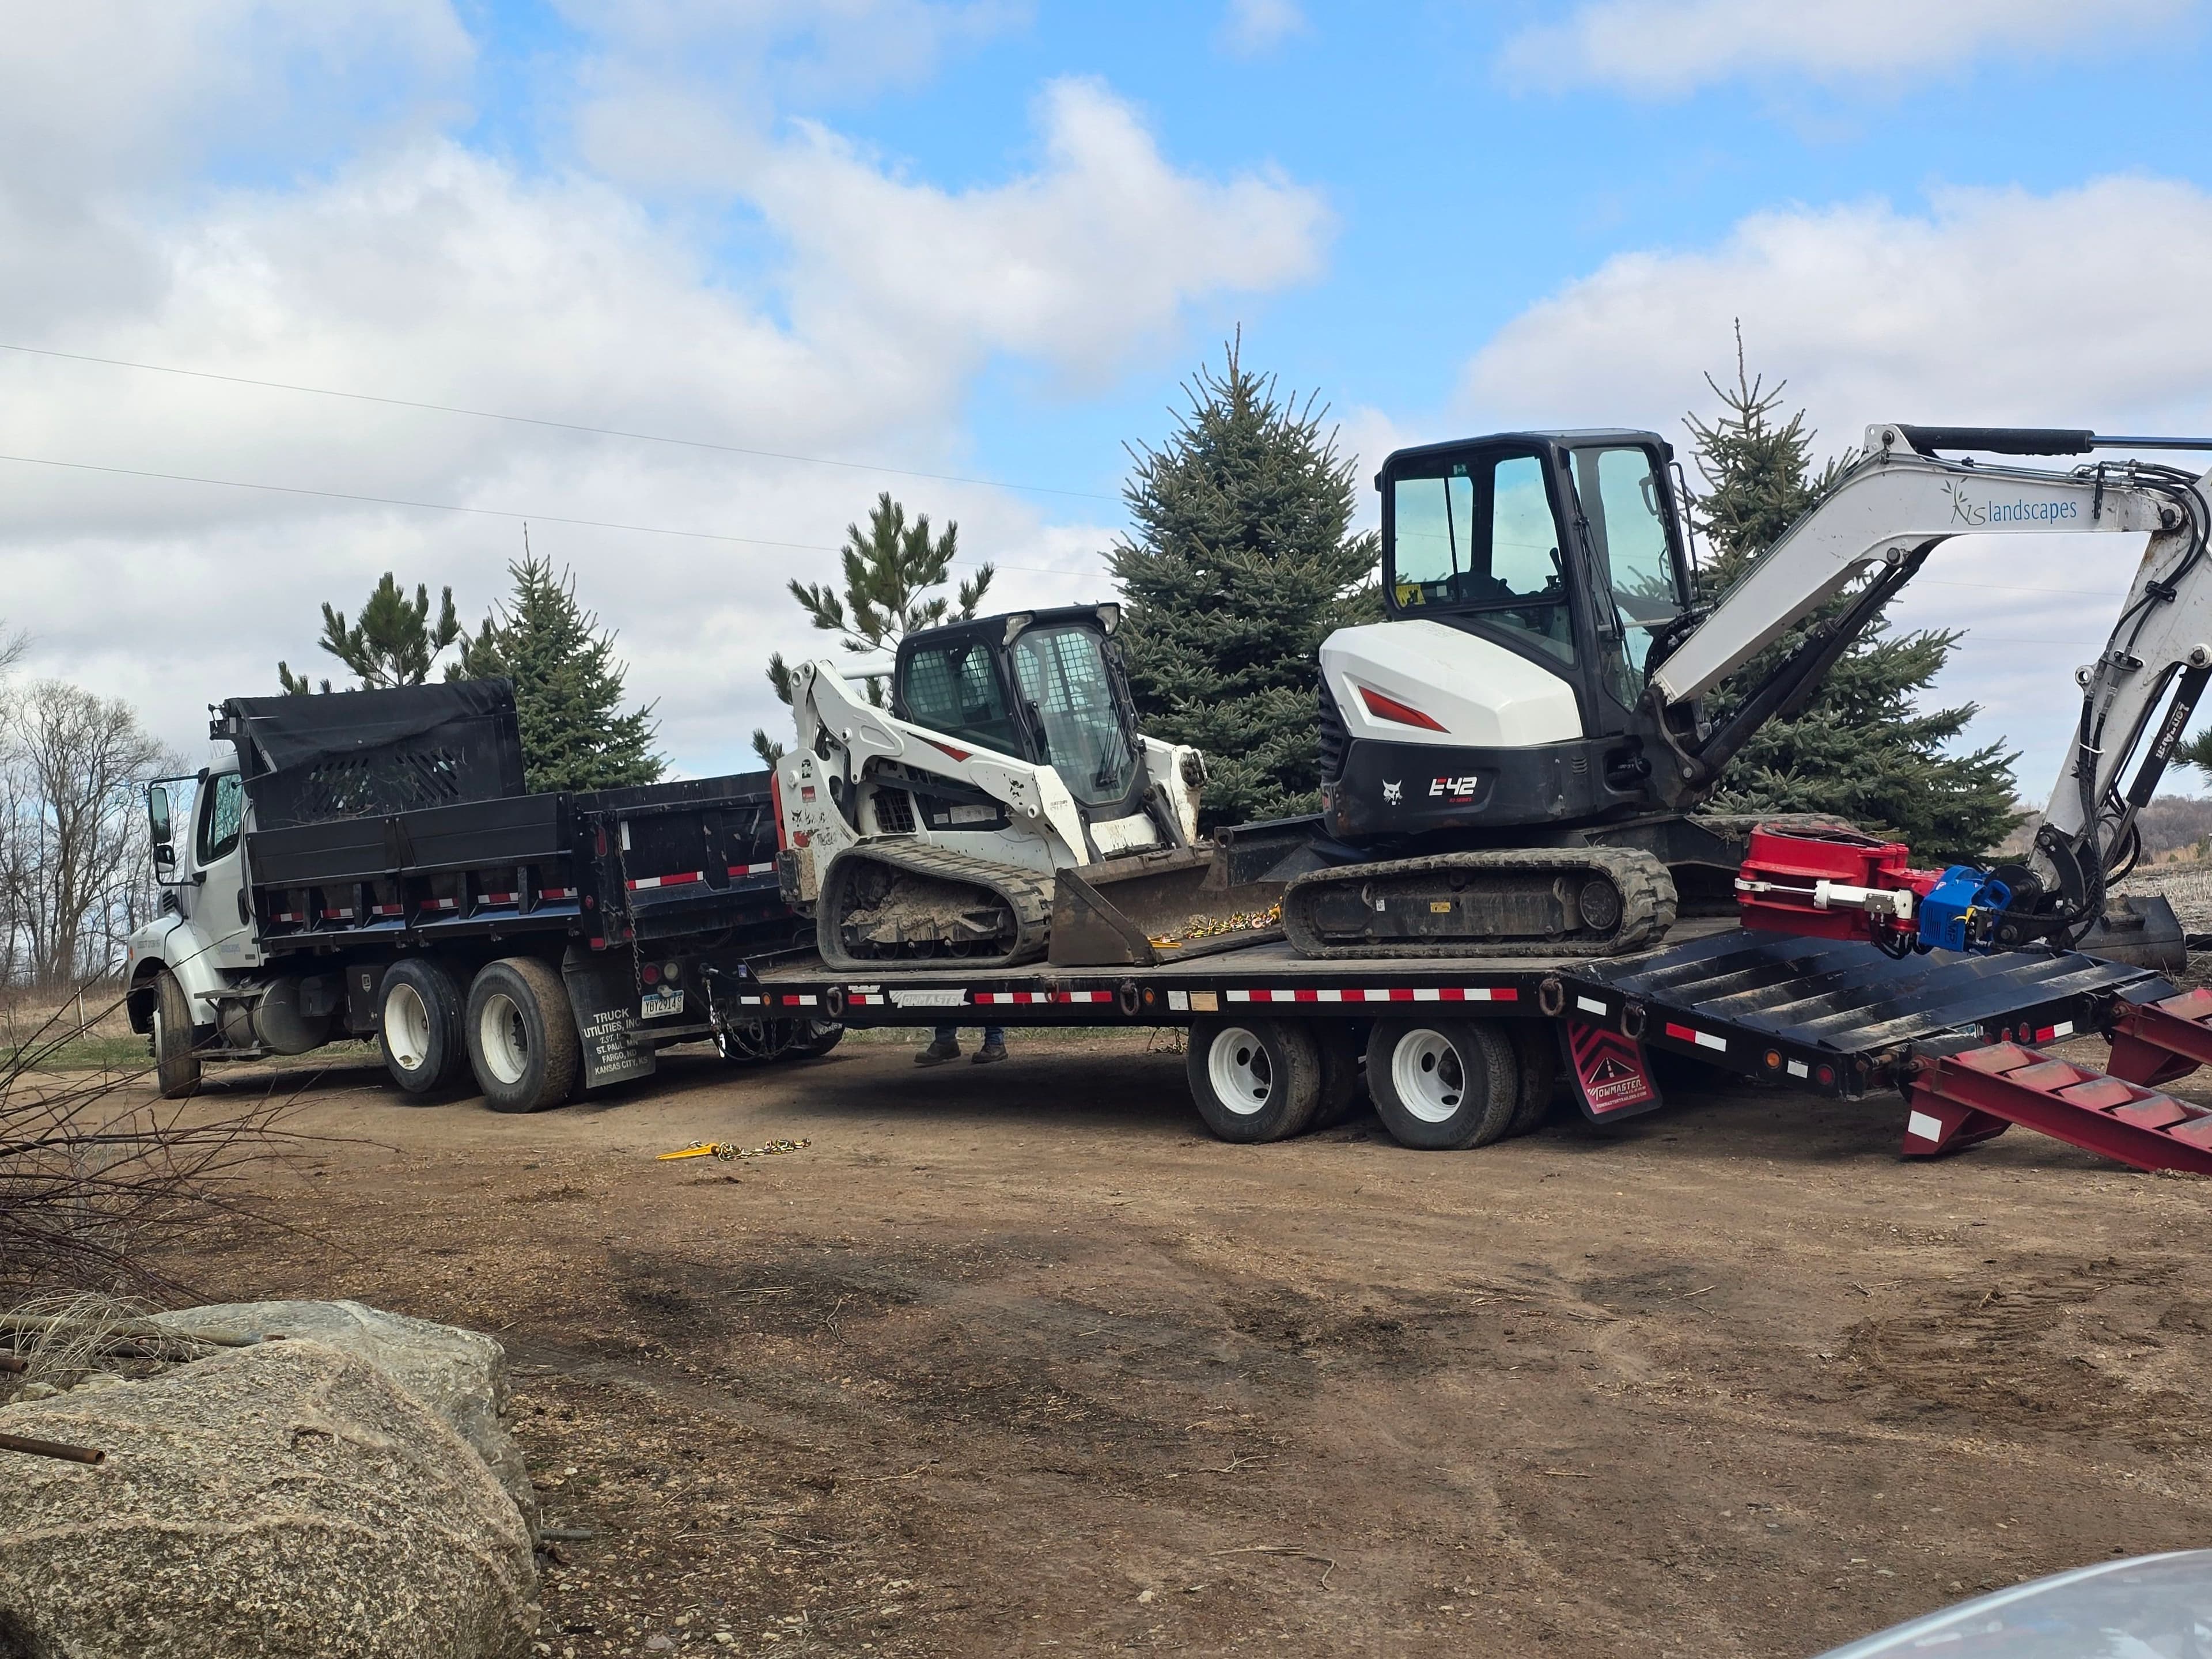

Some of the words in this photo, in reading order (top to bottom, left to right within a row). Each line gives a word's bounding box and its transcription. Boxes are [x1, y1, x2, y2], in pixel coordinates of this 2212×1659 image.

[1988, 499, 2077, 524] landscapes
[1429, 777, 1478, 796] E42
[593, 1008, 629, 1024] TRUCK
[583, 1021, 624, 1038] UTILITIES,
[600, 1034, 615, 1044] EST.
[601, 1051, 626, 1063] FARGO,
[627, 1049, 637, 1057] ND
[594, 1062, 621, 1075] KANSAS
[622, 1059, 638, 1069] CITY,
[638, 1056, 649, 1065] KS
[1587, 1076, 1642, 1101] TOWMASTER
